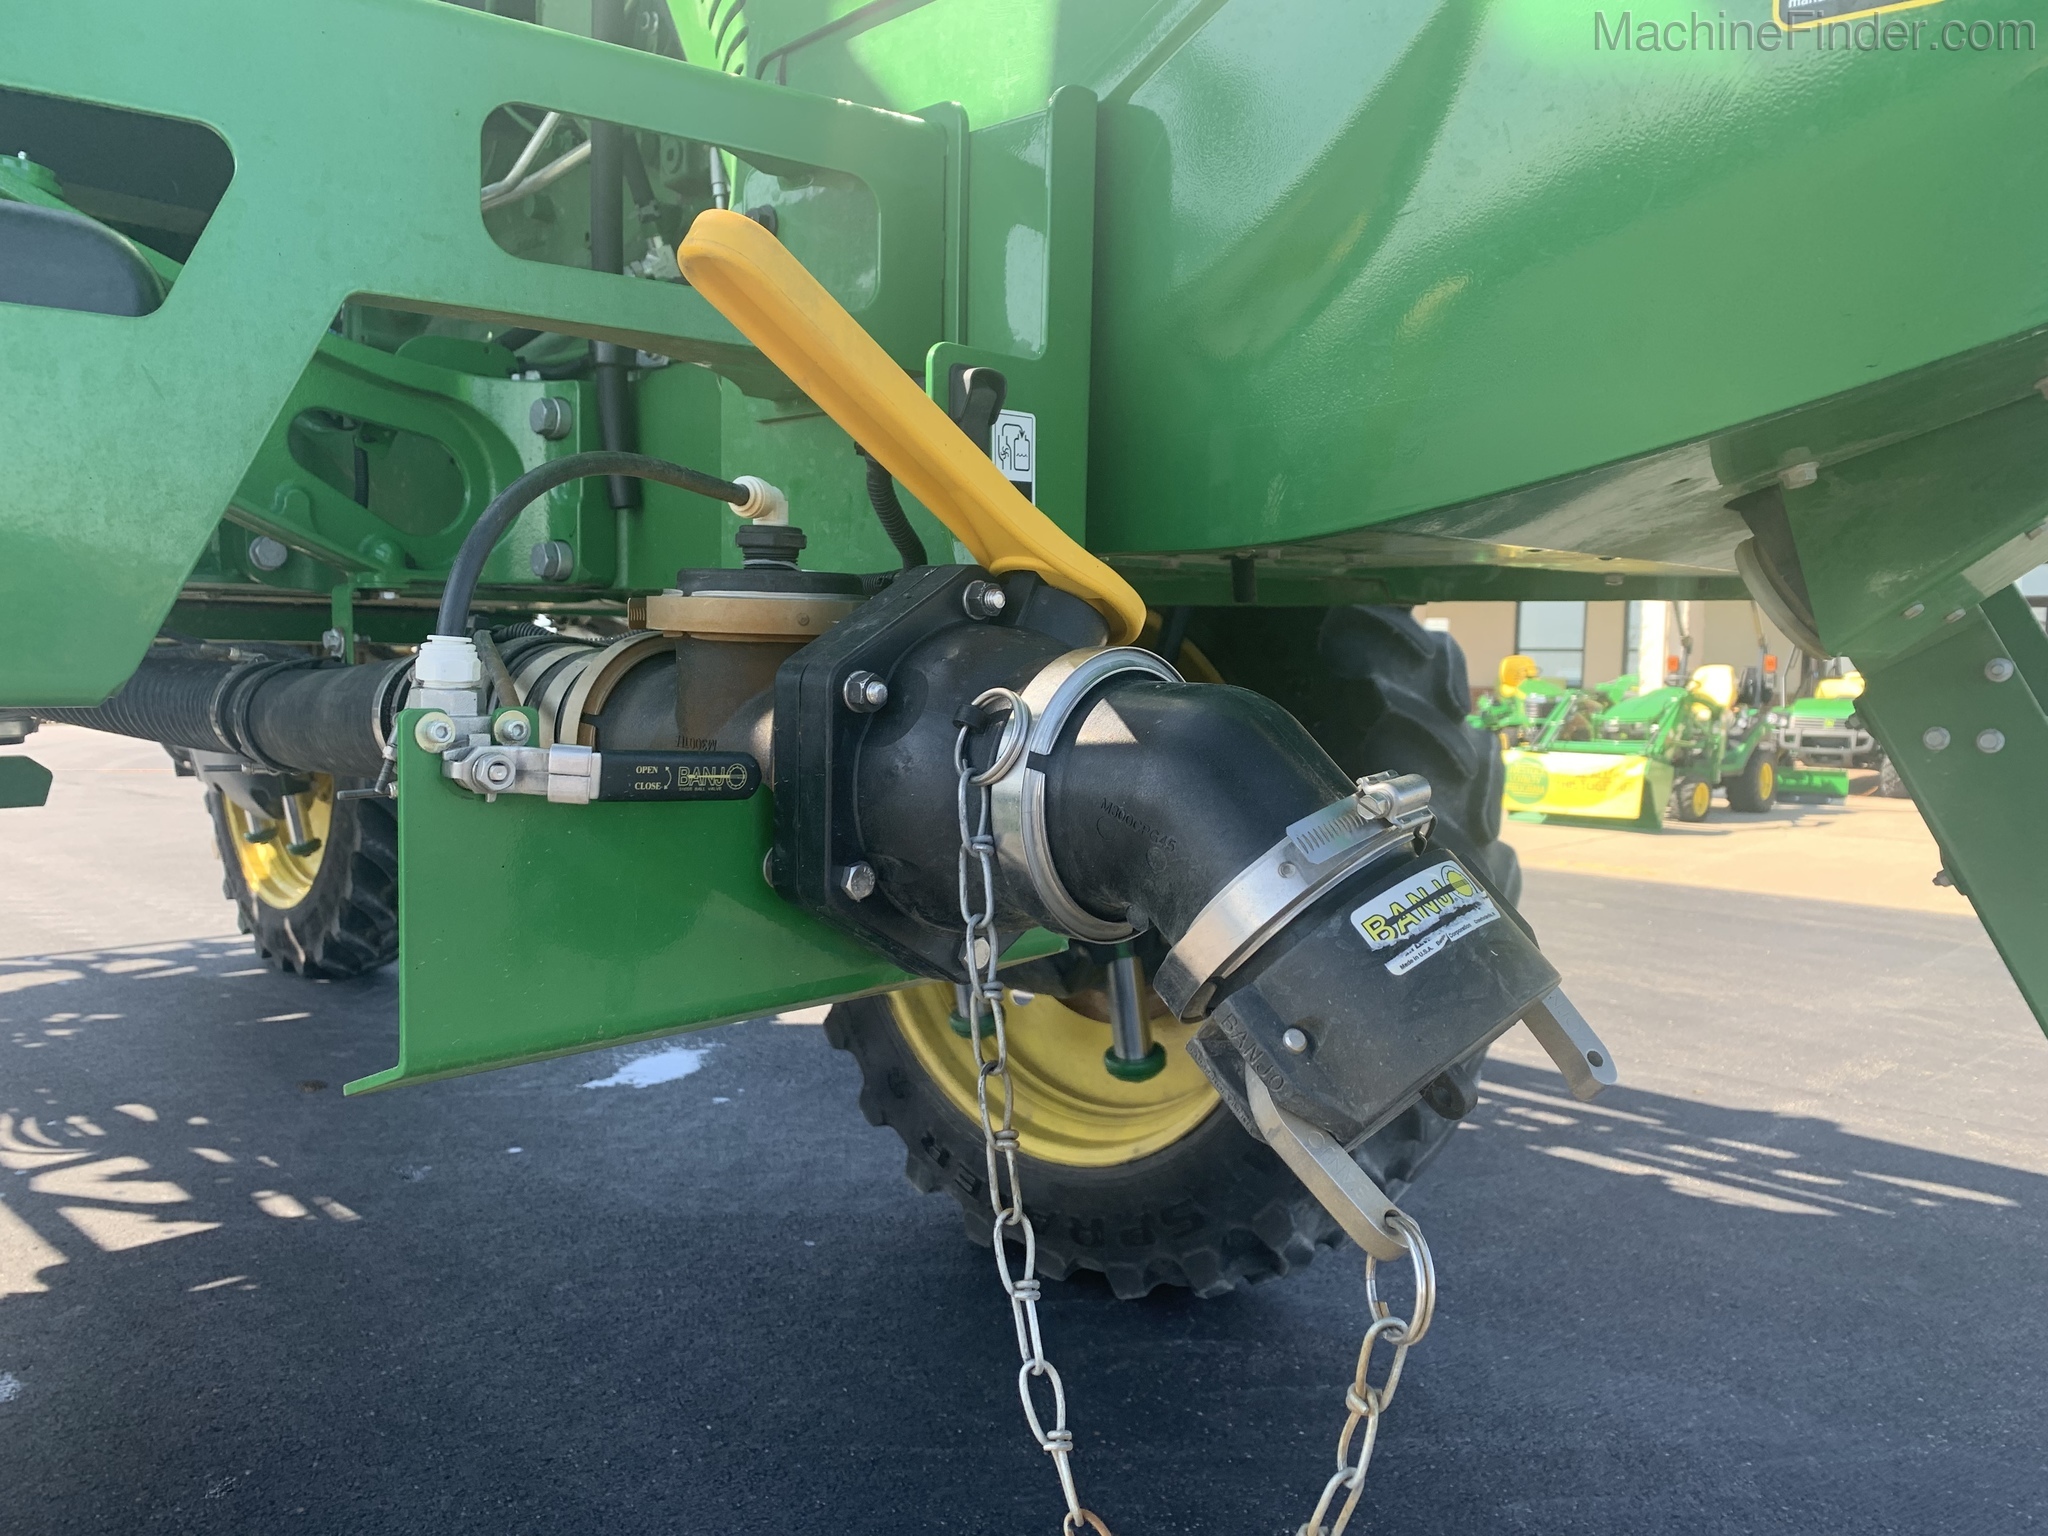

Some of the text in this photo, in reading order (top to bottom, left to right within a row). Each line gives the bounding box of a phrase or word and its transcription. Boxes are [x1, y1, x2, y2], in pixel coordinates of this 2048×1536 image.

[634, 782, 662, 791] CLOSE
[635, 766, 659, 774] OPEN
[678, 763, 748, 790] BANJO
[1361, 865, 1479, 943] BANJO
[1399, 958, 1414, 970] Made
[1449, 923, 1472, 938] Corporation
[1548, 994, 1582, 1033] NJO
[1221, 1013, 1285, 1092] BANJO
